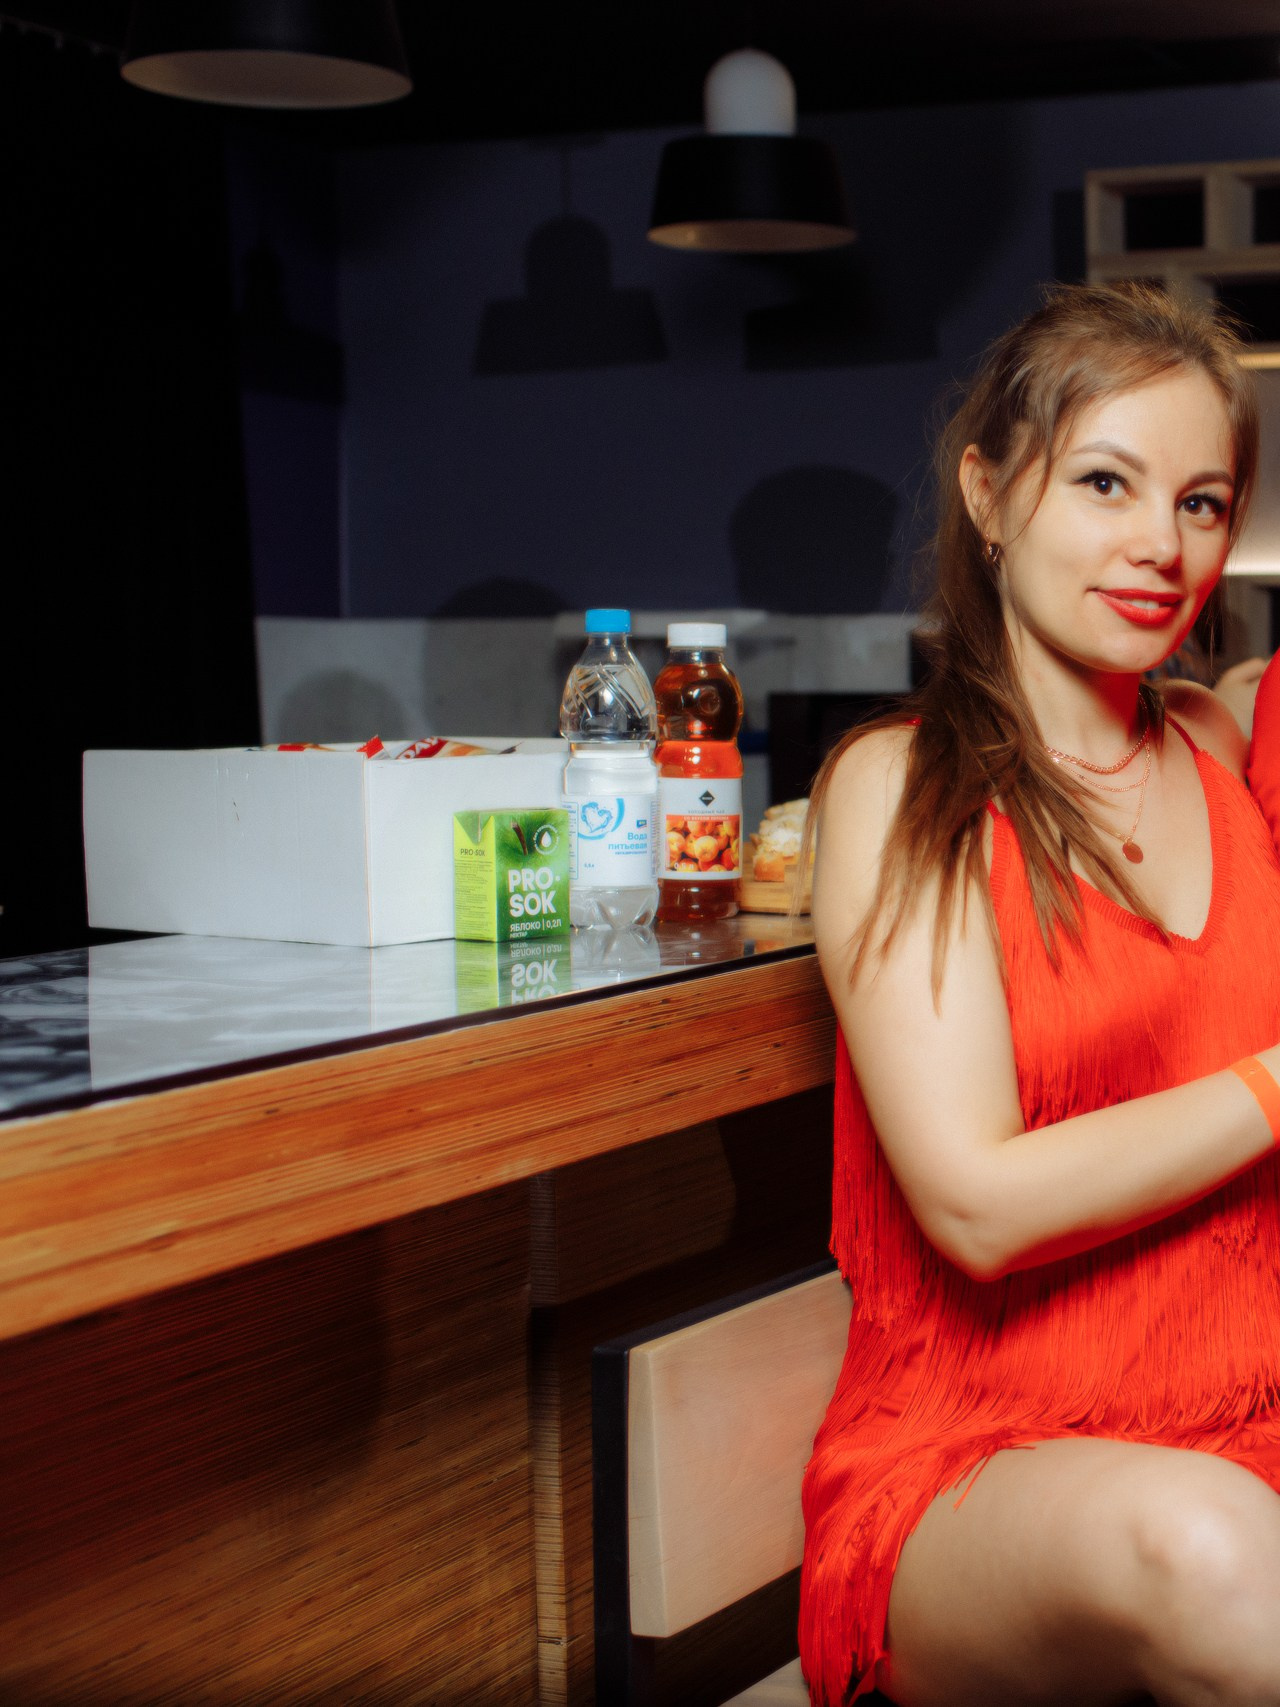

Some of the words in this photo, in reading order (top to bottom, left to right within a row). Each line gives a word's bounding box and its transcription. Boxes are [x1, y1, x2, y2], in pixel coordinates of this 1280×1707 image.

[627, 832, 647, 841] Вода
[510, 890, 557, 917] SOK
[510, 921, 541, 932] ЯБЛОКО
